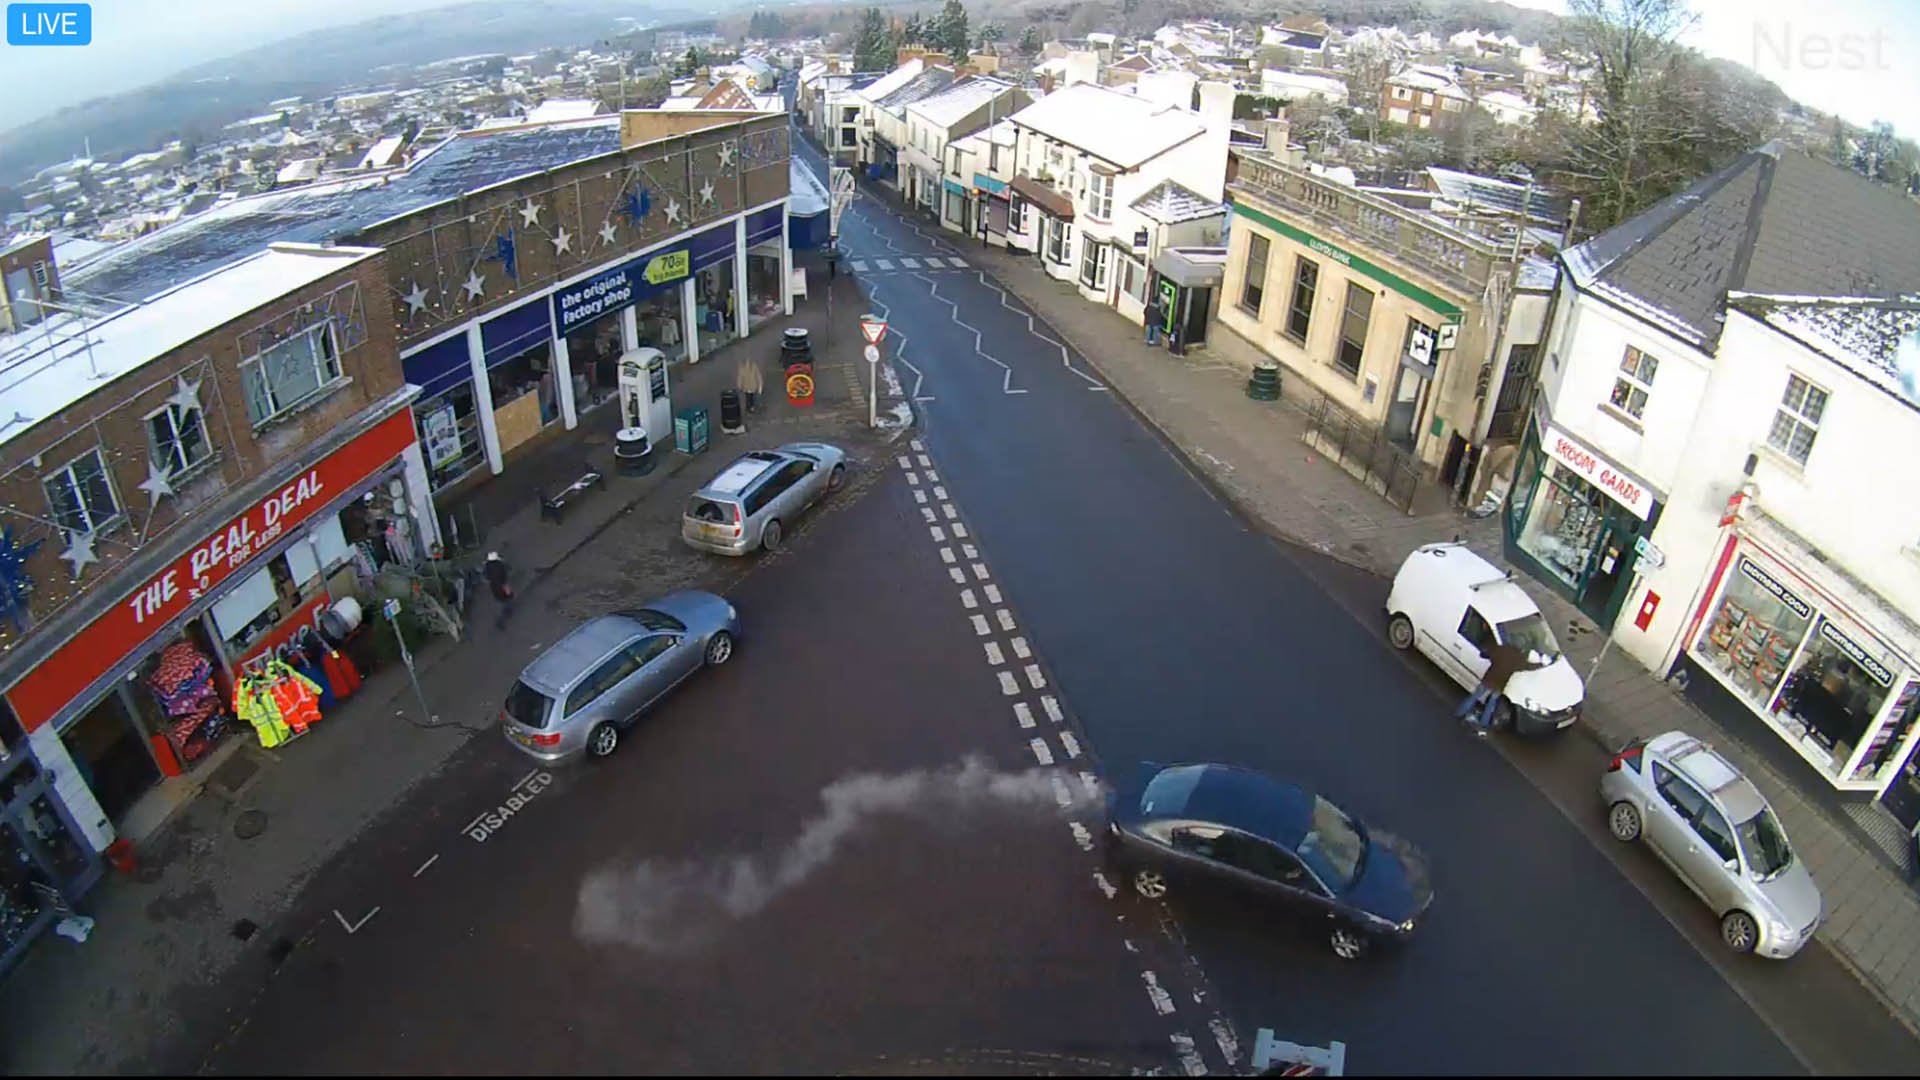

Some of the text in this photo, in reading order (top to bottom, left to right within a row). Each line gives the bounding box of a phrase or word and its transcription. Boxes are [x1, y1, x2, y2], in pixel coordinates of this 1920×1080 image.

[561, 291, 582, 309] the
[583, 271, 627, 300] original
[564, 287, 631, 324] factory shop
[1600, 469, 1641, 504] CARDS
[129, 470, 324, 623] THE REAL DEAL
[228, 543, 251, 569] FOR
[254, 521, 282, 549] LESS
[1782, 590, 1809, 617] COOK
[1863, 655, 1891, 682] COOK
[469, 772, 553, 842] DISABLED
